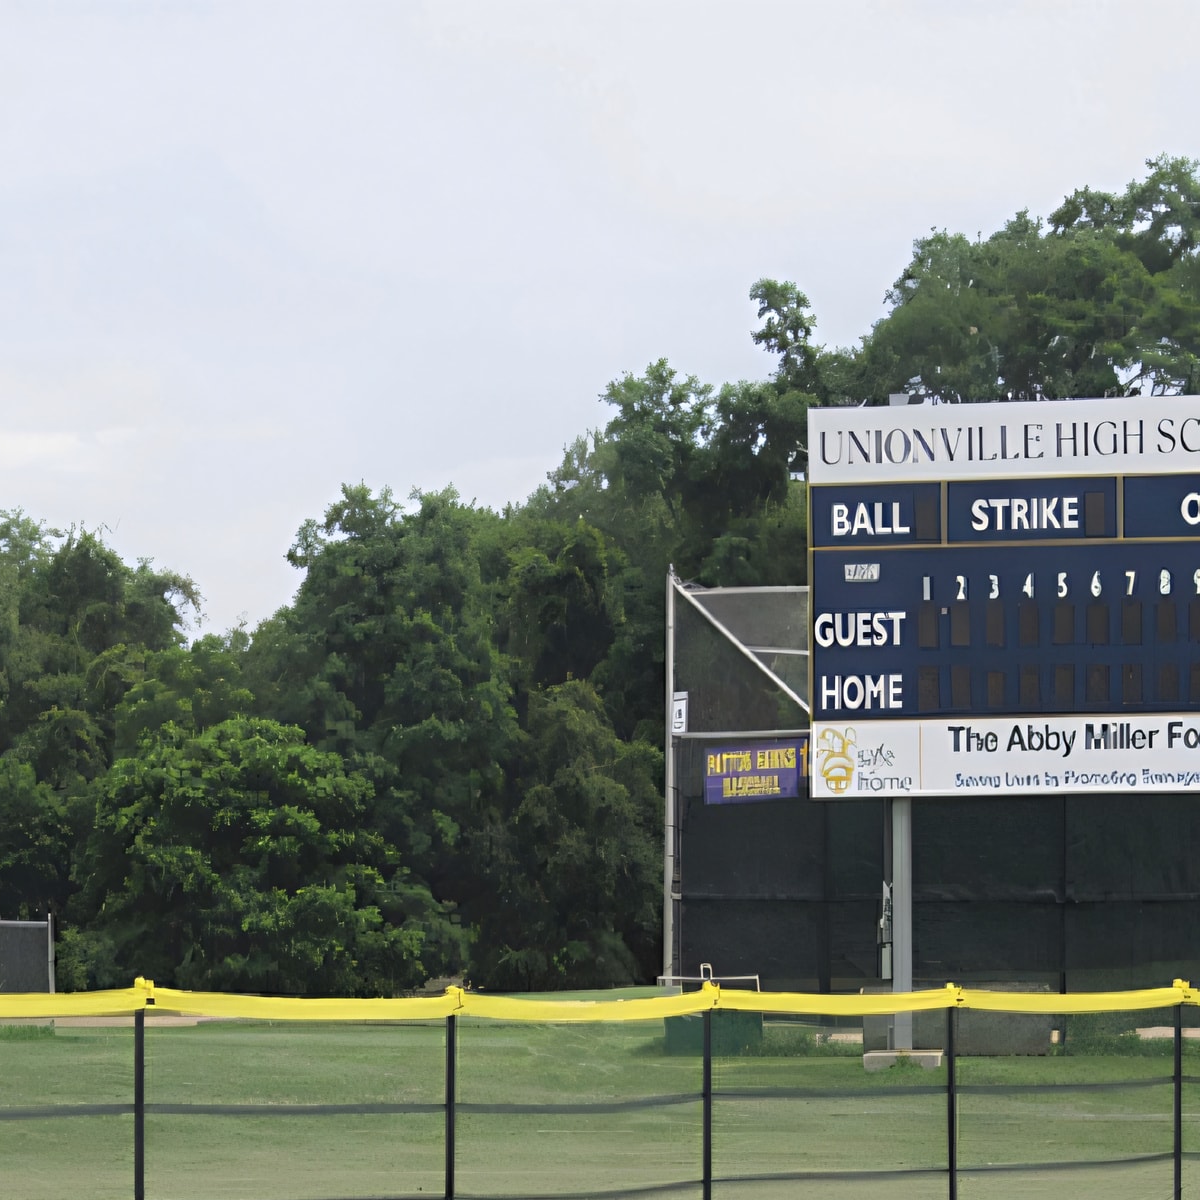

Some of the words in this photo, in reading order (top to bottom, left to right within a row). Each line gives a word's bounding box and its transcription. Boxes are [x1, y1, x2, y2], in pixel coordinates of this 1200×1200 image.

[819, 424, 1044, 465] UNIONVILLE
[1056, 419, 1144, 457] HIGH
[832, 502, 910, 536] BALL
[971, 497, 1079, 531] STRIKE
[956, 575, 967, 600] 2
[989, 574, 999, 599] 3
[1022, 572, 1035, 599] 4
[1057, 572, 1068, 598] 5
[1091, 570, 1102, 598] 6
[1125, 571, 1136, 596] 7
[1160, 569, 1171, 595] 8
[814, 611, 907, 648] GUEST
[821, 674, 903, 710] HOME
[947, 725, 999, 753] The
[1006, 723, 1077, 758] Abby
[1084, 722, 1160, 750] Miller
